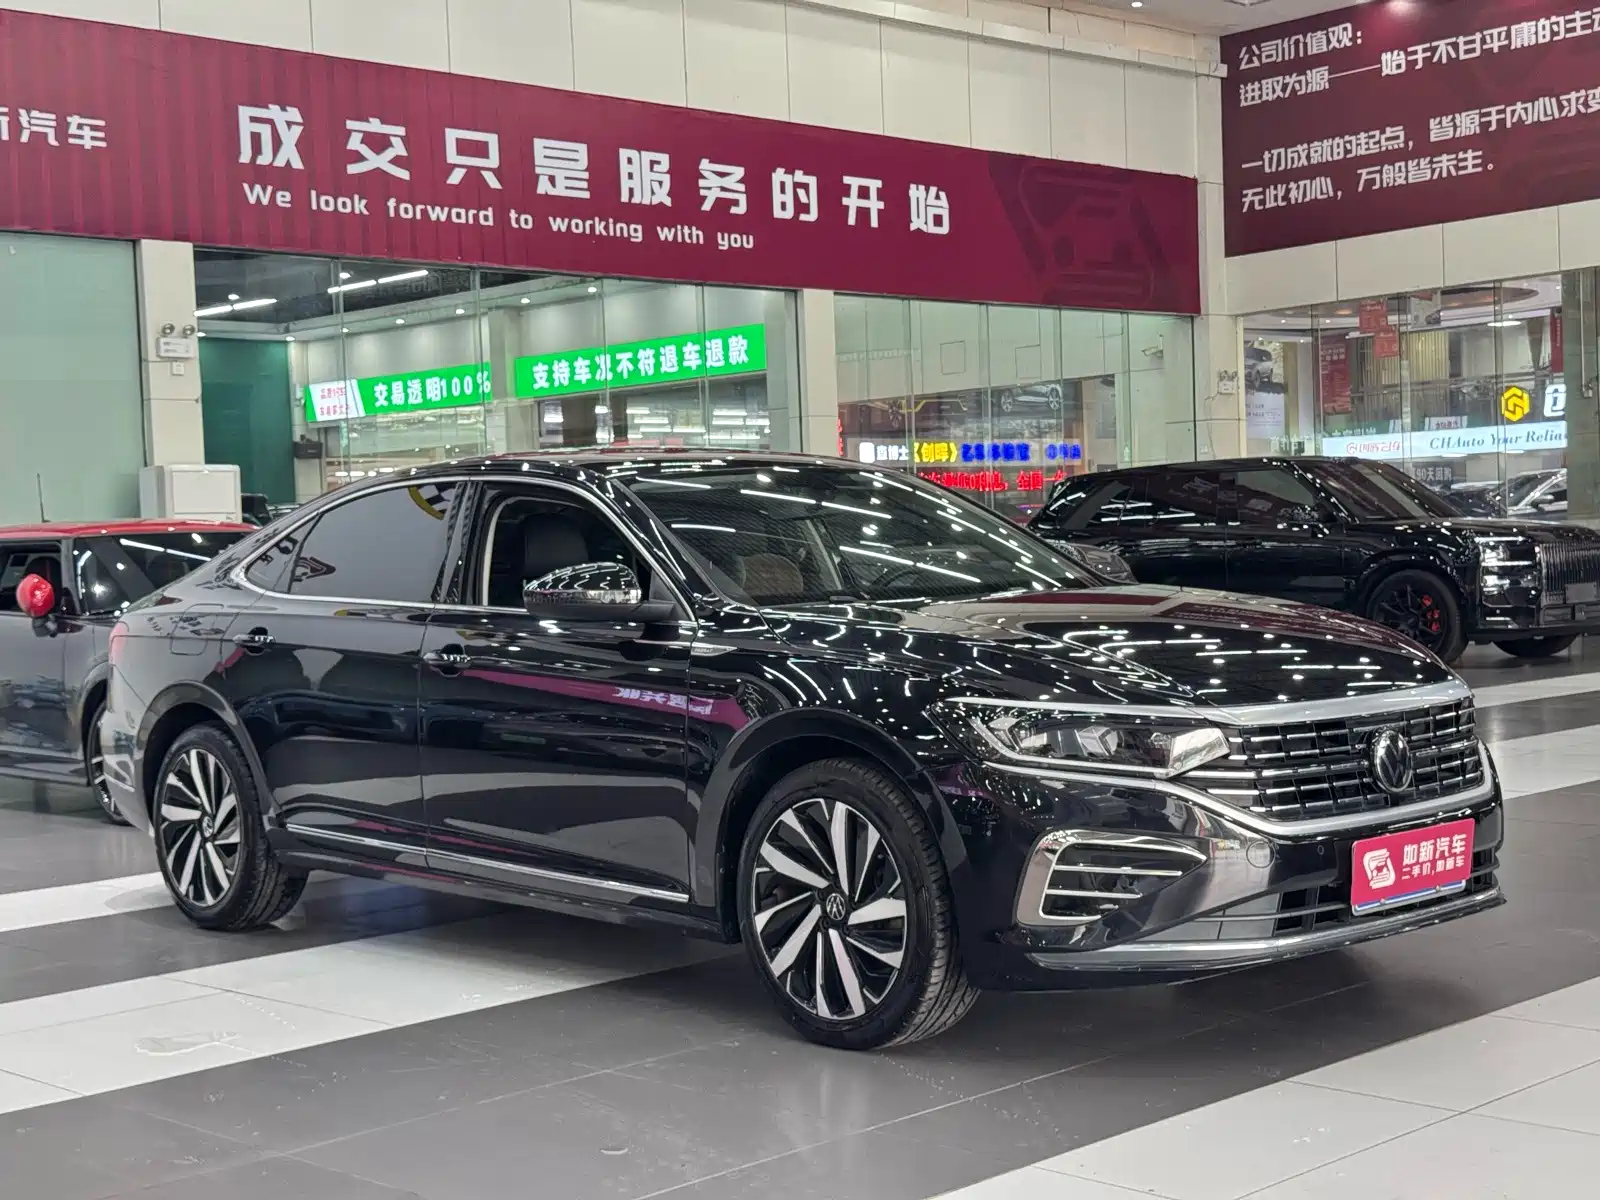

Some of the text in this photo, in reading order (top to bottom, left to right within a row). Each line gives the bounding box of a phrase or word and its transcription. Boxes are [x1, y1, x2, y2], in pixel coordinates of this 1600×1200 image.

[1239, 22, 1364, 70] 公司价值观：
[237, 103, 951, 236] 成交只是服务的开始
[243, 183, 755, 251] We look forward to working with you
[532, 334, 749, 391] 支持车况不符退车退款
[373, 371, 491, 408] 交易透明100%
[1402, 833, 1467, 865] 如新汽车
